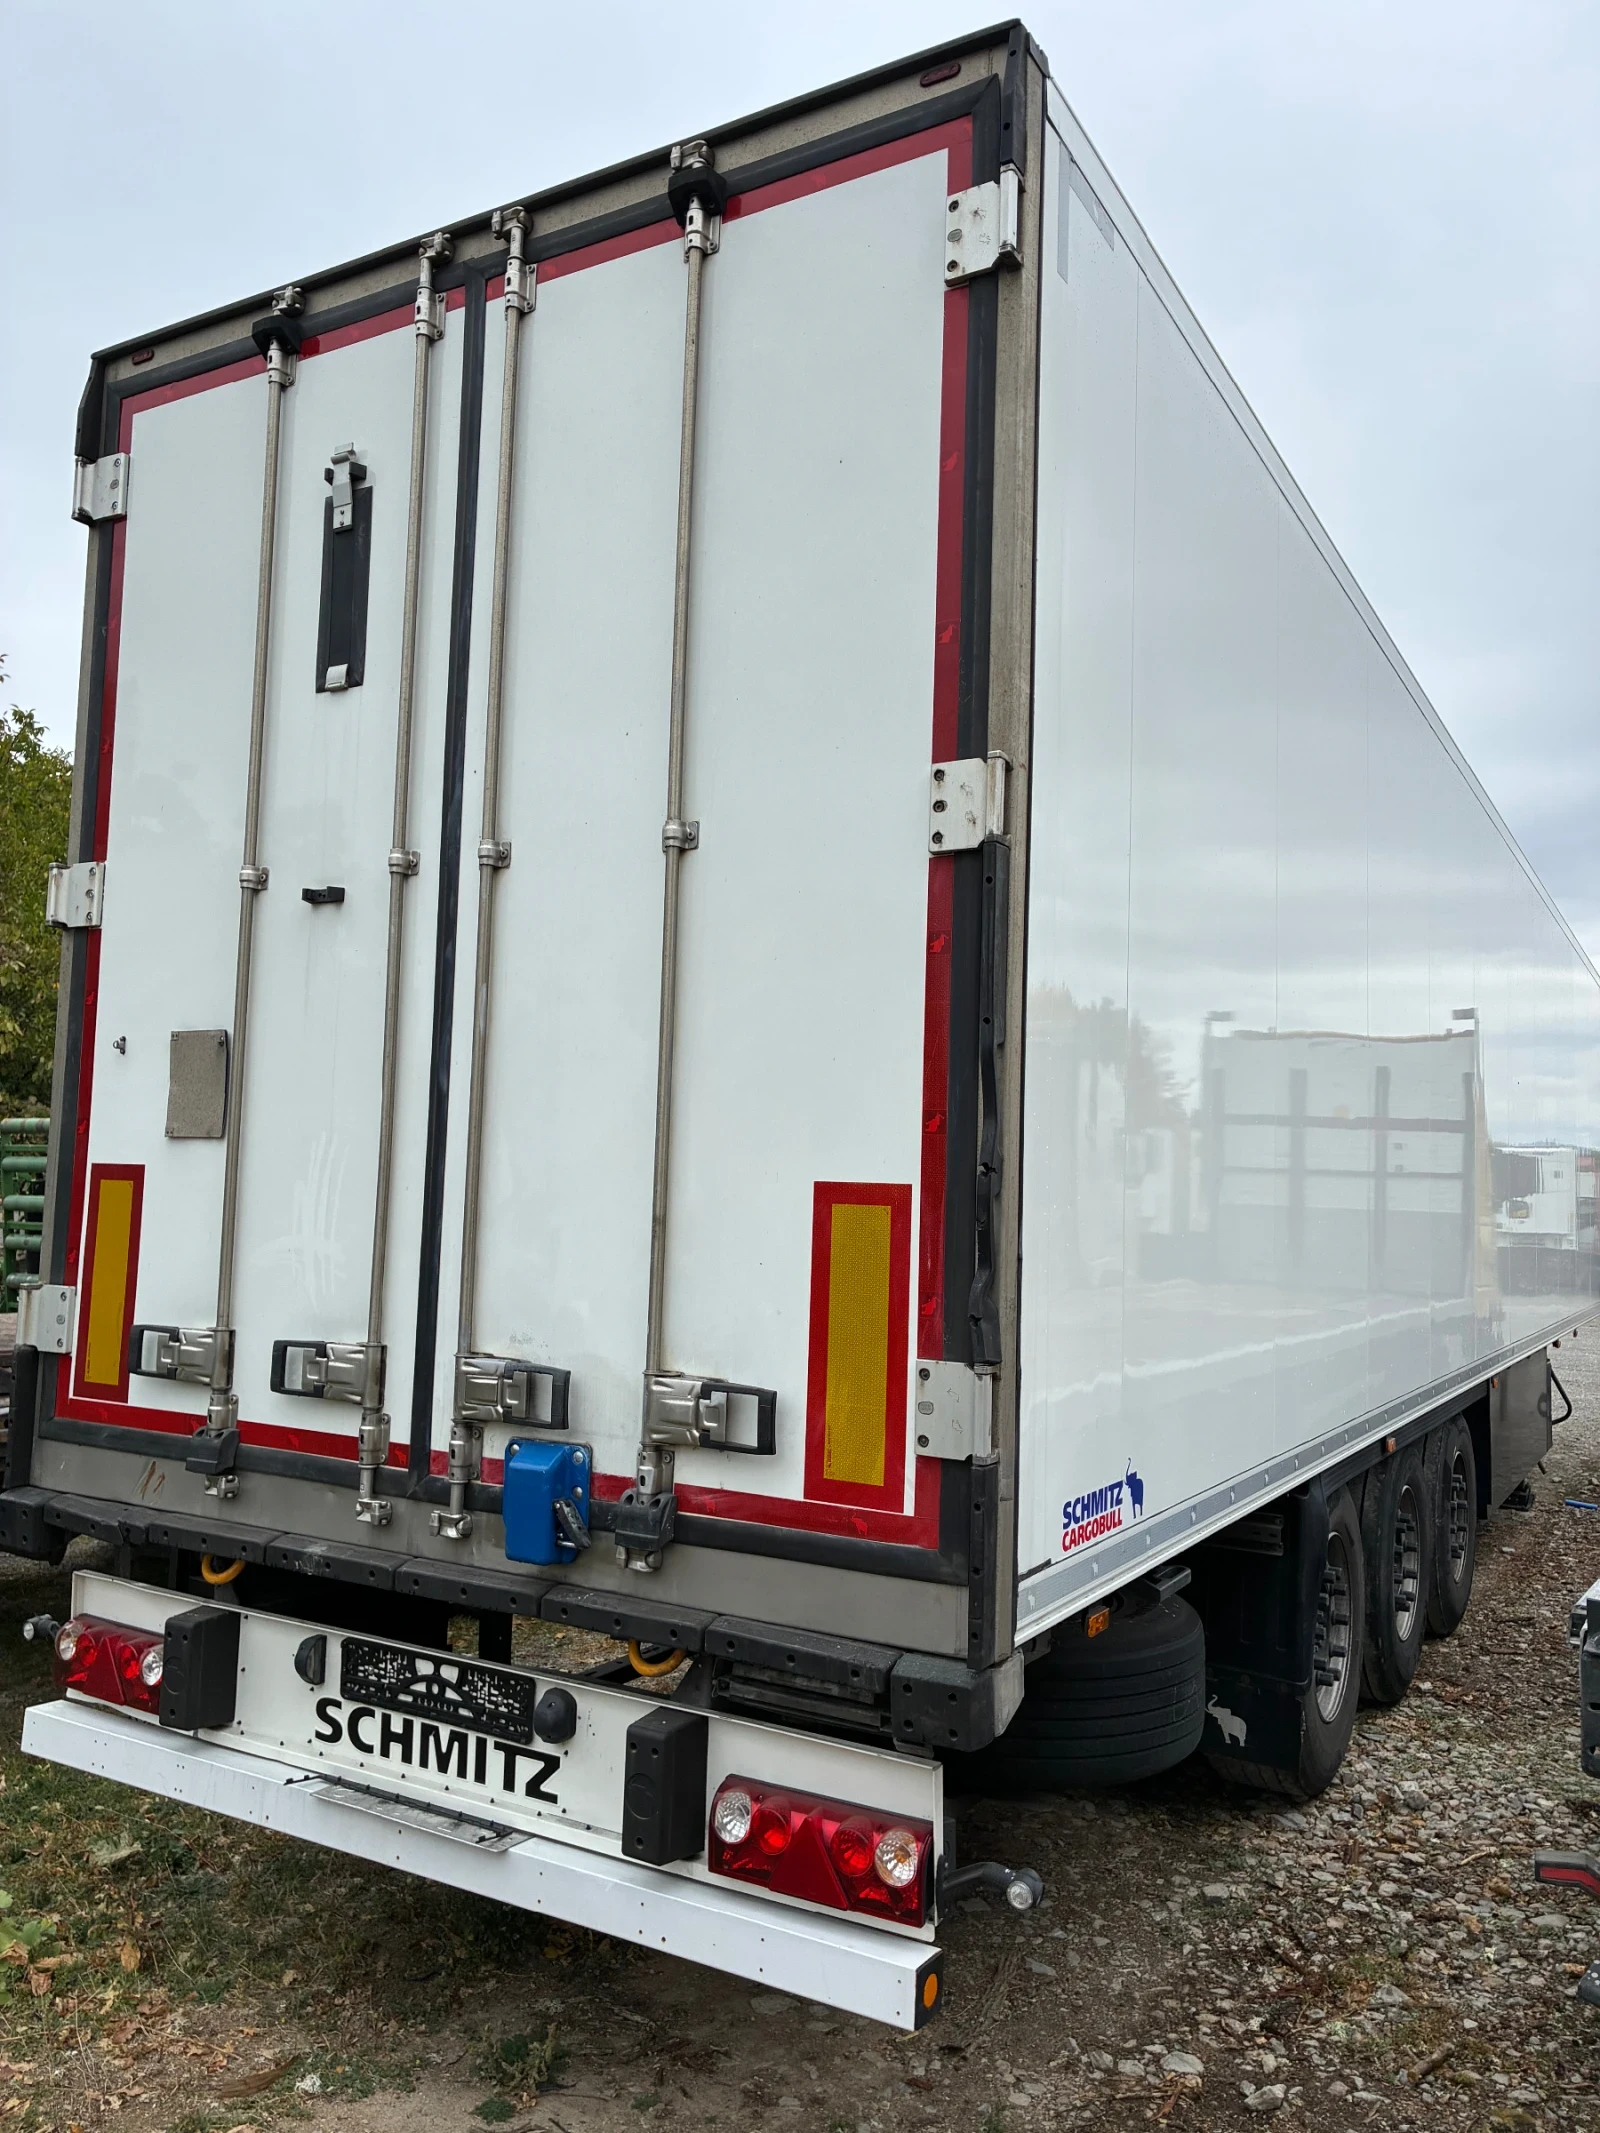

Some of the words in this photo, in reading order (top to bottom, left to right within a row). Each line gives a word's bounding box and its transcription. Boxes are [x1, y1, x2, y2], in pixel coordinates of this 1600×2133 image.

[1062, 1480, 1124, 1530] SCHMITZ
[1062, 1507, 1123, 1552] CARGOBULL
[315, 1697, 561, 1804] SCHMITZ
